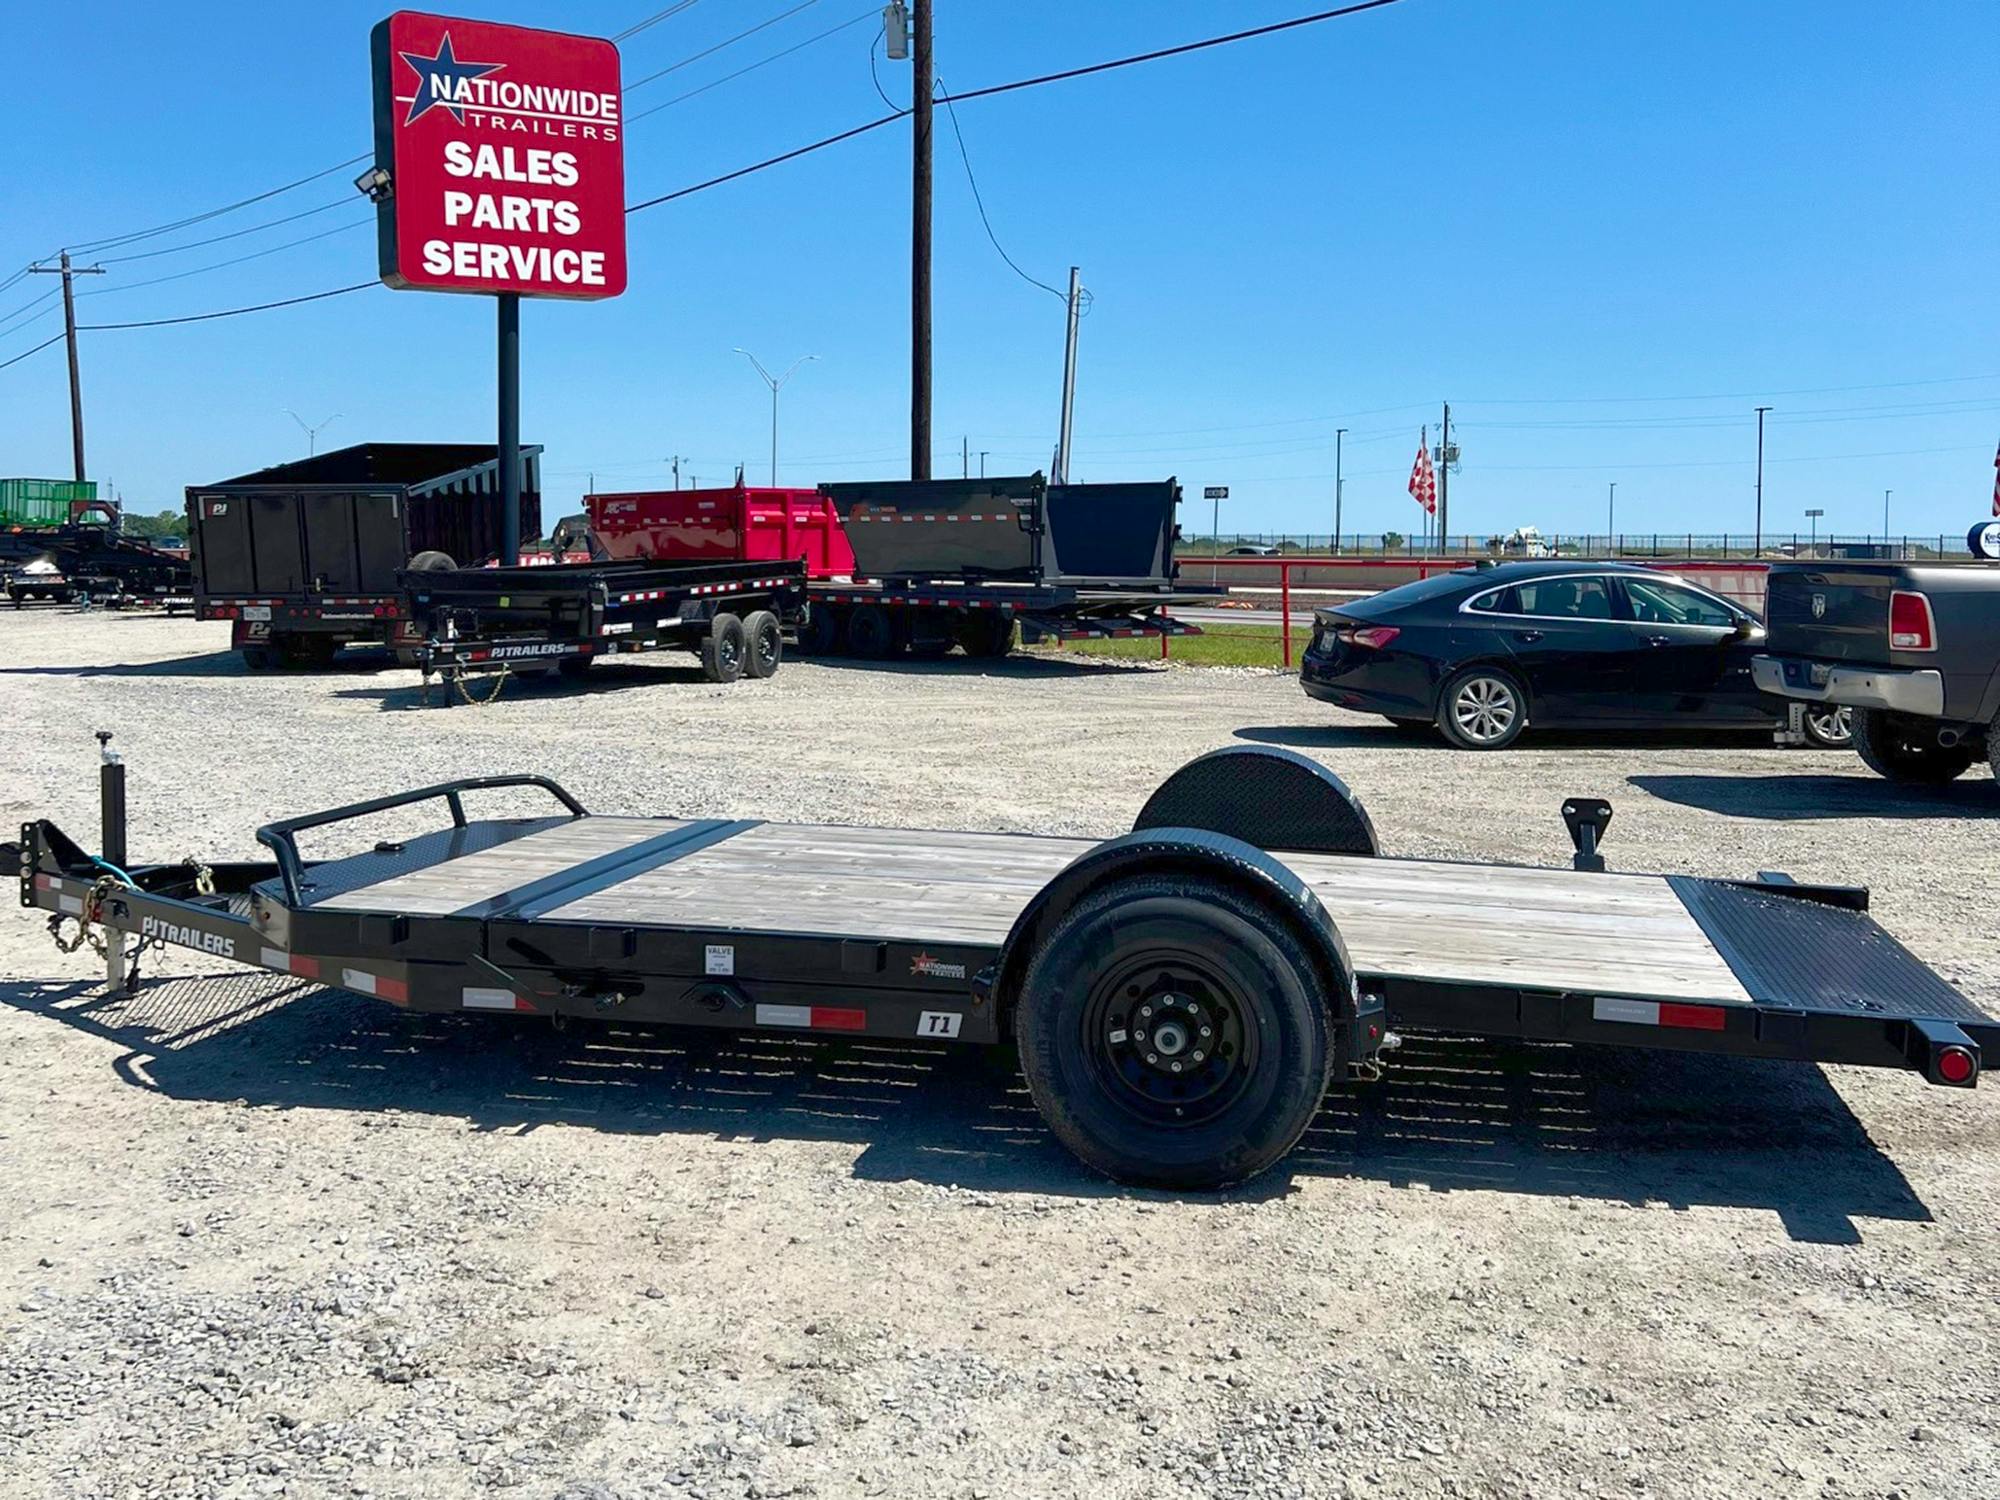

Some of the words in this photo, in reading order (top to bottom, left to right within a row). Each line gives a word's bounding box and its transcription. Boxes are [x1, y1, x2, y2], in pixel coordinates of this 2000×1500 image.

[430, 73, 618, 119] NATIONWIDE
[469, 113, 617, 142] TRAILERS
[444, 141, 579, 187] SALES
[444, 191, 581, 235] PARTS
[422, 240, 605, 285] SERVICE
[928, 1015, 951, 1034] T1
